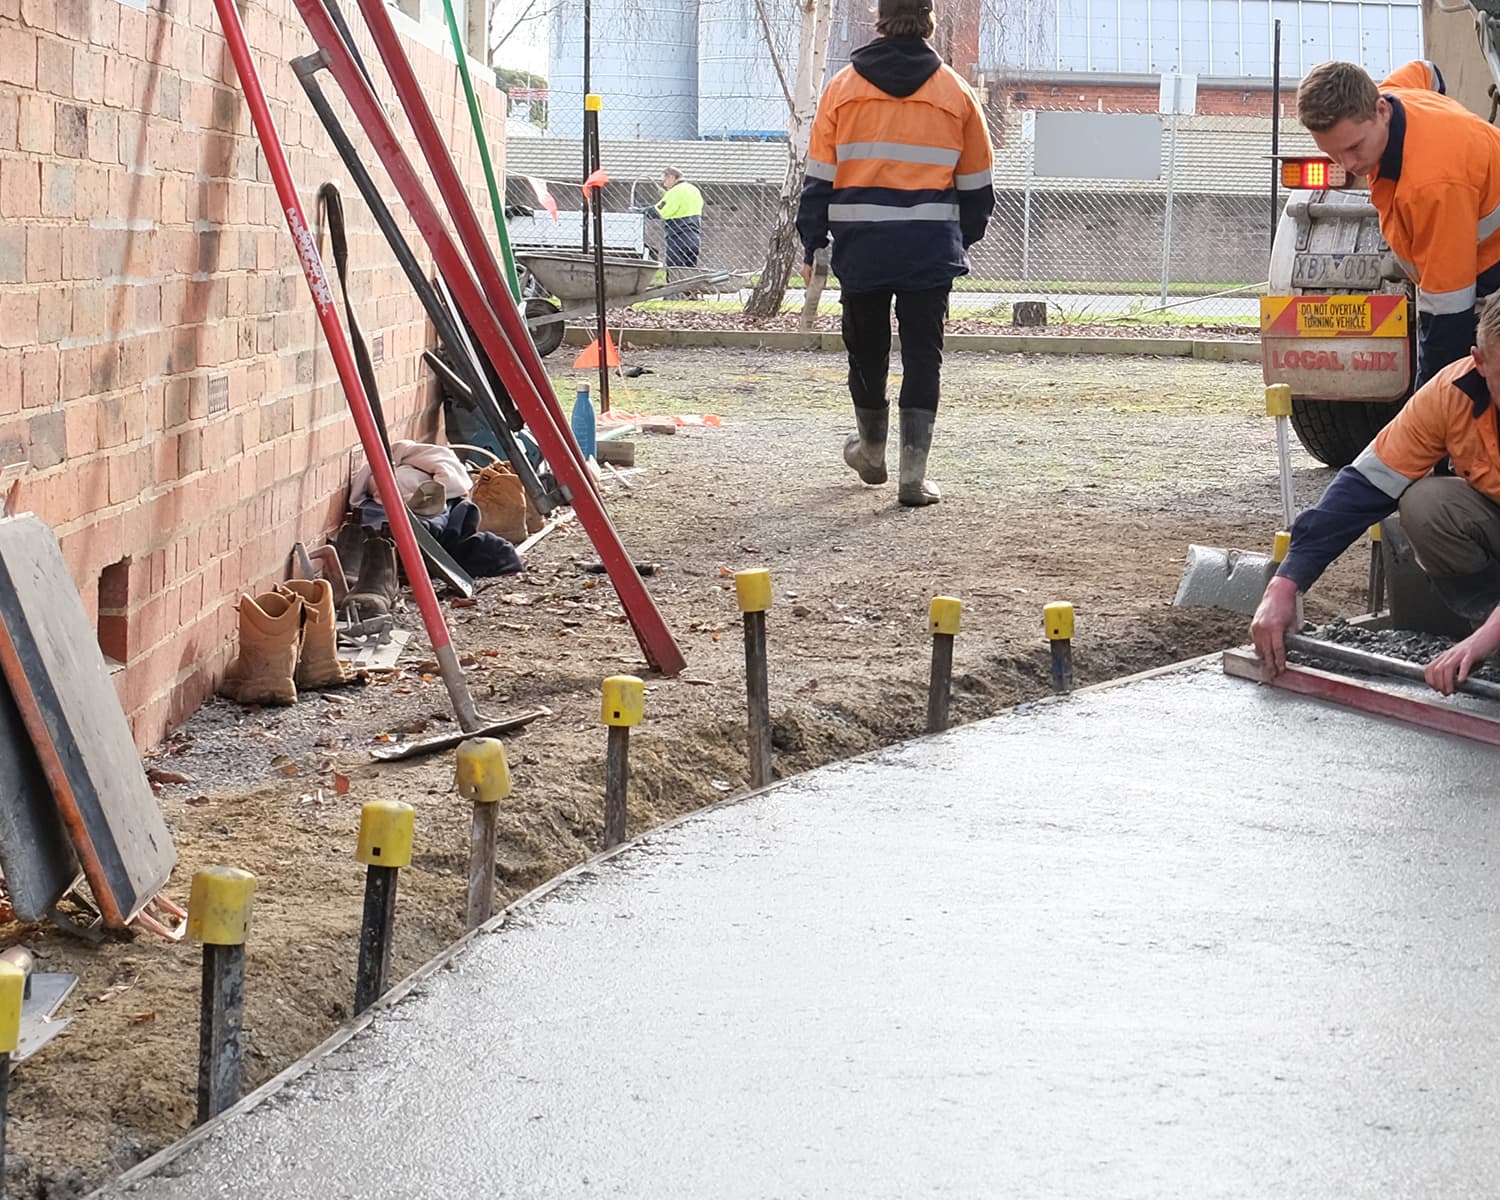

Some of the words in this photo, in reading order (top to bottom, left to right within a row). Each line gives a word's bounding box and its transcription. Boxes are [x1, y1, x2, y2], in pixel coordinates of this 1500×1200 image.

[1301, 303, 1312, 315] DO
[1314, 303, 1328, 315] NOT
[1329, 303, 1367, 315] OVERTAKE
[1303, 316, 1334, 328] TURNING
[1336, 316, 1366, 328] VEHICLE
[1272, 350, 1344, 371] LOCAL
[1352, 351, 1398, 371] MIX
